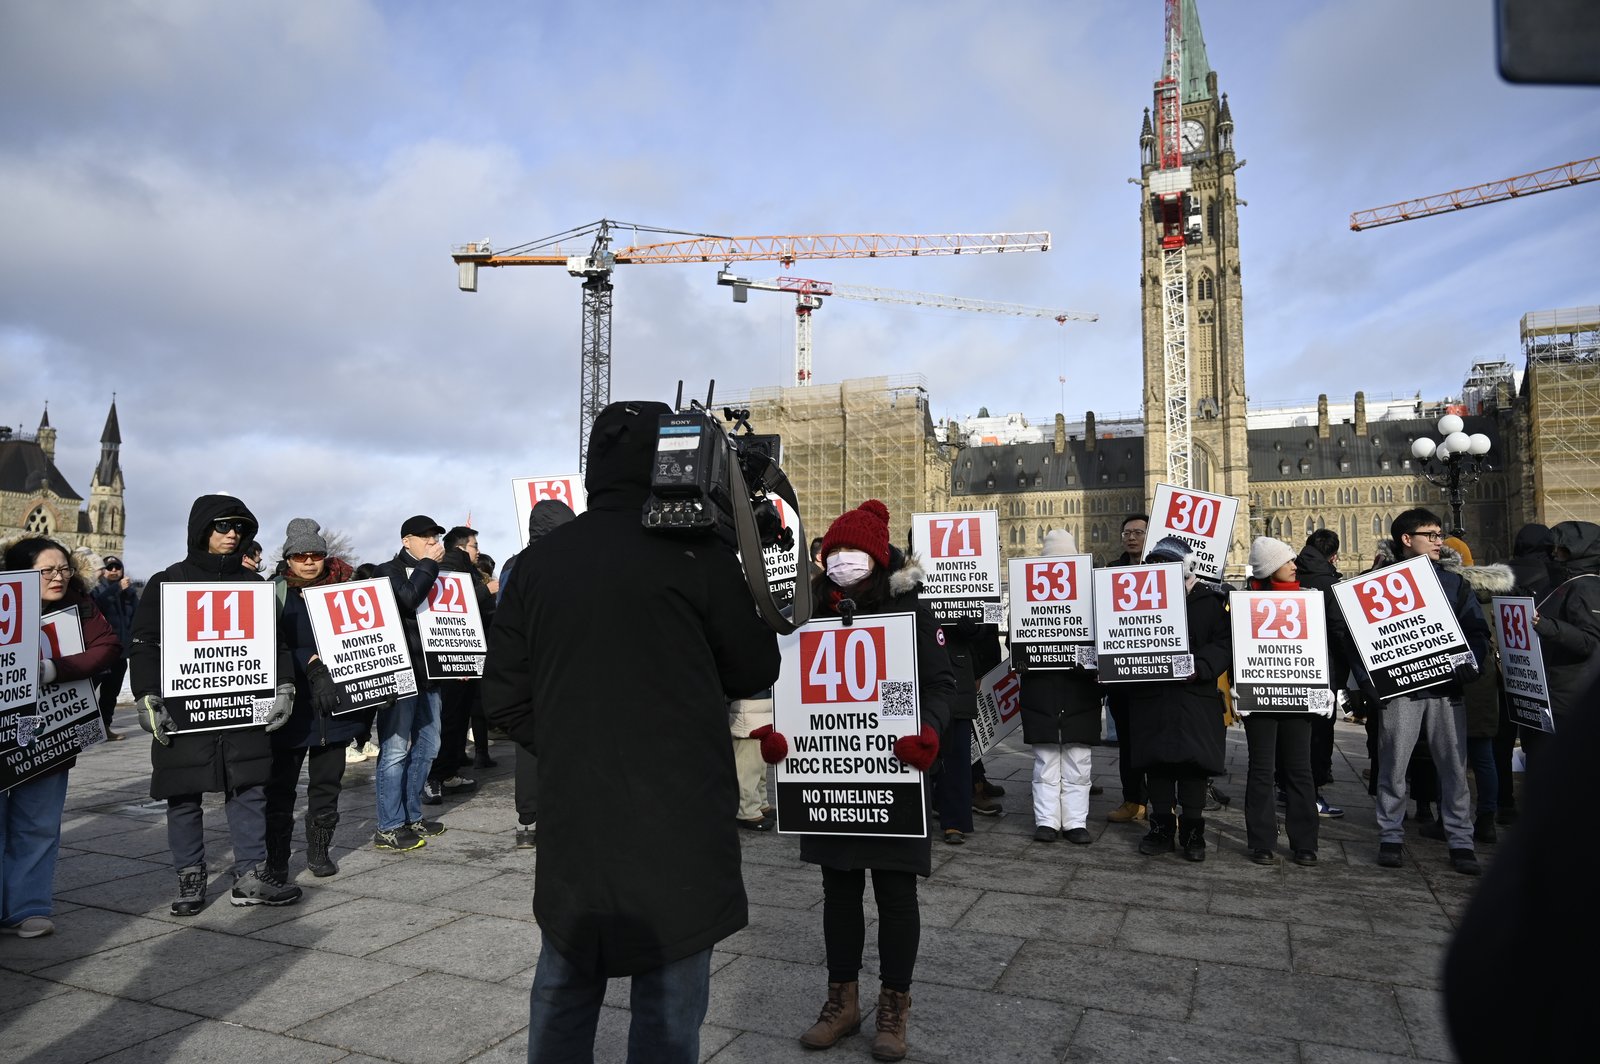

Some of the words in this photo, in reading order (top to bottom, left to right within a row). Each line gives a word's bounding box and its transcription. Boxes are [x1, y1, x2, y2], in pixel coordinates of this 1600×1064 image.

[535, 481, 568, 506] 53
[1171, 495, 1214, 534] 30
[936, 519, 975, 556] 71
[777, 553, 794, 564] FOR
[1196, 552, 1215, 562] FOR
[936, 561, 977, 570] MONTHS
[927, 573, 966, 582] WAITING
[969, 572, 988, 581] FOR
[1032, 563, 1071, 600] 53
[769, 580, 795, 592] ELINES
[944, 584, 994, 593] RESPONSE
[1118, 570, 1162, 610] 34
[433, 577, 463, 612] 22
[1363, 573, 1415, 619] 39
[334, 589, 375, 632] 19
[944, 601, 984, 609] TIMELINES
[1031, 605, 1071, 615] MONTHS
[197, 592, 245, 640] 11
[436, 617, 466, 626] MONTHS
[1021, 617, 1060, 626] WAITING
[1064, 617, 1082, 625] FOR
[1119, 615, 1162, 625] MONTHS
[1257, 599, 1301, 638] 23
[430, 628, 460, 636] WAITING
[462, 629, 476, 637] FOR
[1109, 627, 1151, 637] WAITING
[1154, 626, 1174, 635] FOR
[1378, 614, 1426, 636] MONTHS
[1504, 606, 1526, 649] 33
[1016, 630, 1036, 638] IRCC
[1038, 628, 1088, 637] RESPONSE
[1372, 630, 1418, 651] WAITING
[1420, 622, 1444, 637] FOR
[342, 633, 383, 649] MONTHS
[427, 639, 444, 647] IRCC
[446, 639, 482, 647] RESPONSE
[1104, 641, 1125, 650] IRCC
[1127, 637, 1181, 649] RESPONSE
[1370, 651, 1395, 665] IRCC
[1396, 632, 1456, 658] RESPONSE
[194, 646, 247, 659] MONTHS
[334, 648, 376, 664] WAITING
[378, 644, 396, 655] FOR
[1258, 645, 1302, 654] MONTHS
[809, 629, 877, 701] 40
[1043, 654, 1076, 662] RESULTS
[1127, 655, 1171, 665] TIMELINES
[1247, 657, 1291, 666] WAITING
[1295, 657, 1314, 666] FOR
[1388, 667, 1401, 678] NO
[1402, 653, 1451, 673] TIMELINES
[1509, 654, 1530, 666] MONTHS
[180, 661, 234, 675] WAITING
[238, 660, 261, 671] FOR
[331, 665, 354, 678] IRCC
[356, 654, 404, 673] RESPONSE
[1118, 667, 1130, 675] NO
[1132, 666, 1168, 674] RESULTS
[1507, 666, 1527, 679] WAITING
[1527, 670, 1538, 680] FOR
[6, 668, 26, 684] FOR
[172, 678, 201, 690] IRCC
[203, 673, 268, 688] RESPONSE
[1242, 669, 1264, 678] IRCC
[1267, 670, 1321, 679] RESPONSE
[1396, 676, 1410, 686] NO
[1412, 665, 1452, 682] RESULTS
[345, 683, 357, 693] NO
[351, 693, 363, 703] NO
[365, 685, 397, 700] RESULTS
[1253, 687, 1265, 695] NO
[1517, 681, 1543, 695] RESPONSE
[52, 688, 78, 707] FOR
[185, 700, 200, 710] NO
[203, 695, 256, 708] TIMELINES
[995, 678, 1019, 715] 15
[1258, 697, 1269, 705] NO
[44, 698, 89, 726] PONSE
[190, 712, 205, 722] NO
[208, 707, 252, 720] RESULTS
[977, 690, 989, 721] WAITING
[986, 721, 994, 738] FOR
[986, 693, 999, 725] MONTHS
[810, 712, 878, 730] MONTHS
[794, 736, 861, 752] WAITING
[866, 735, 897, 751] FOR
[7, 752, 23, 765] NO
[15, 762, 31, 775] NO
[33, 737, 80, 766] RESULTS
[786, 758, 820, 774] IRCC
[823, 756, 909, 774] RESPONSE
[802, 789, 820, 803] NO
[823, 790, 894, 804] TIMELINES
[809, 808, 827, 821] NO
[831, 808, 889, 823] RESULTS
